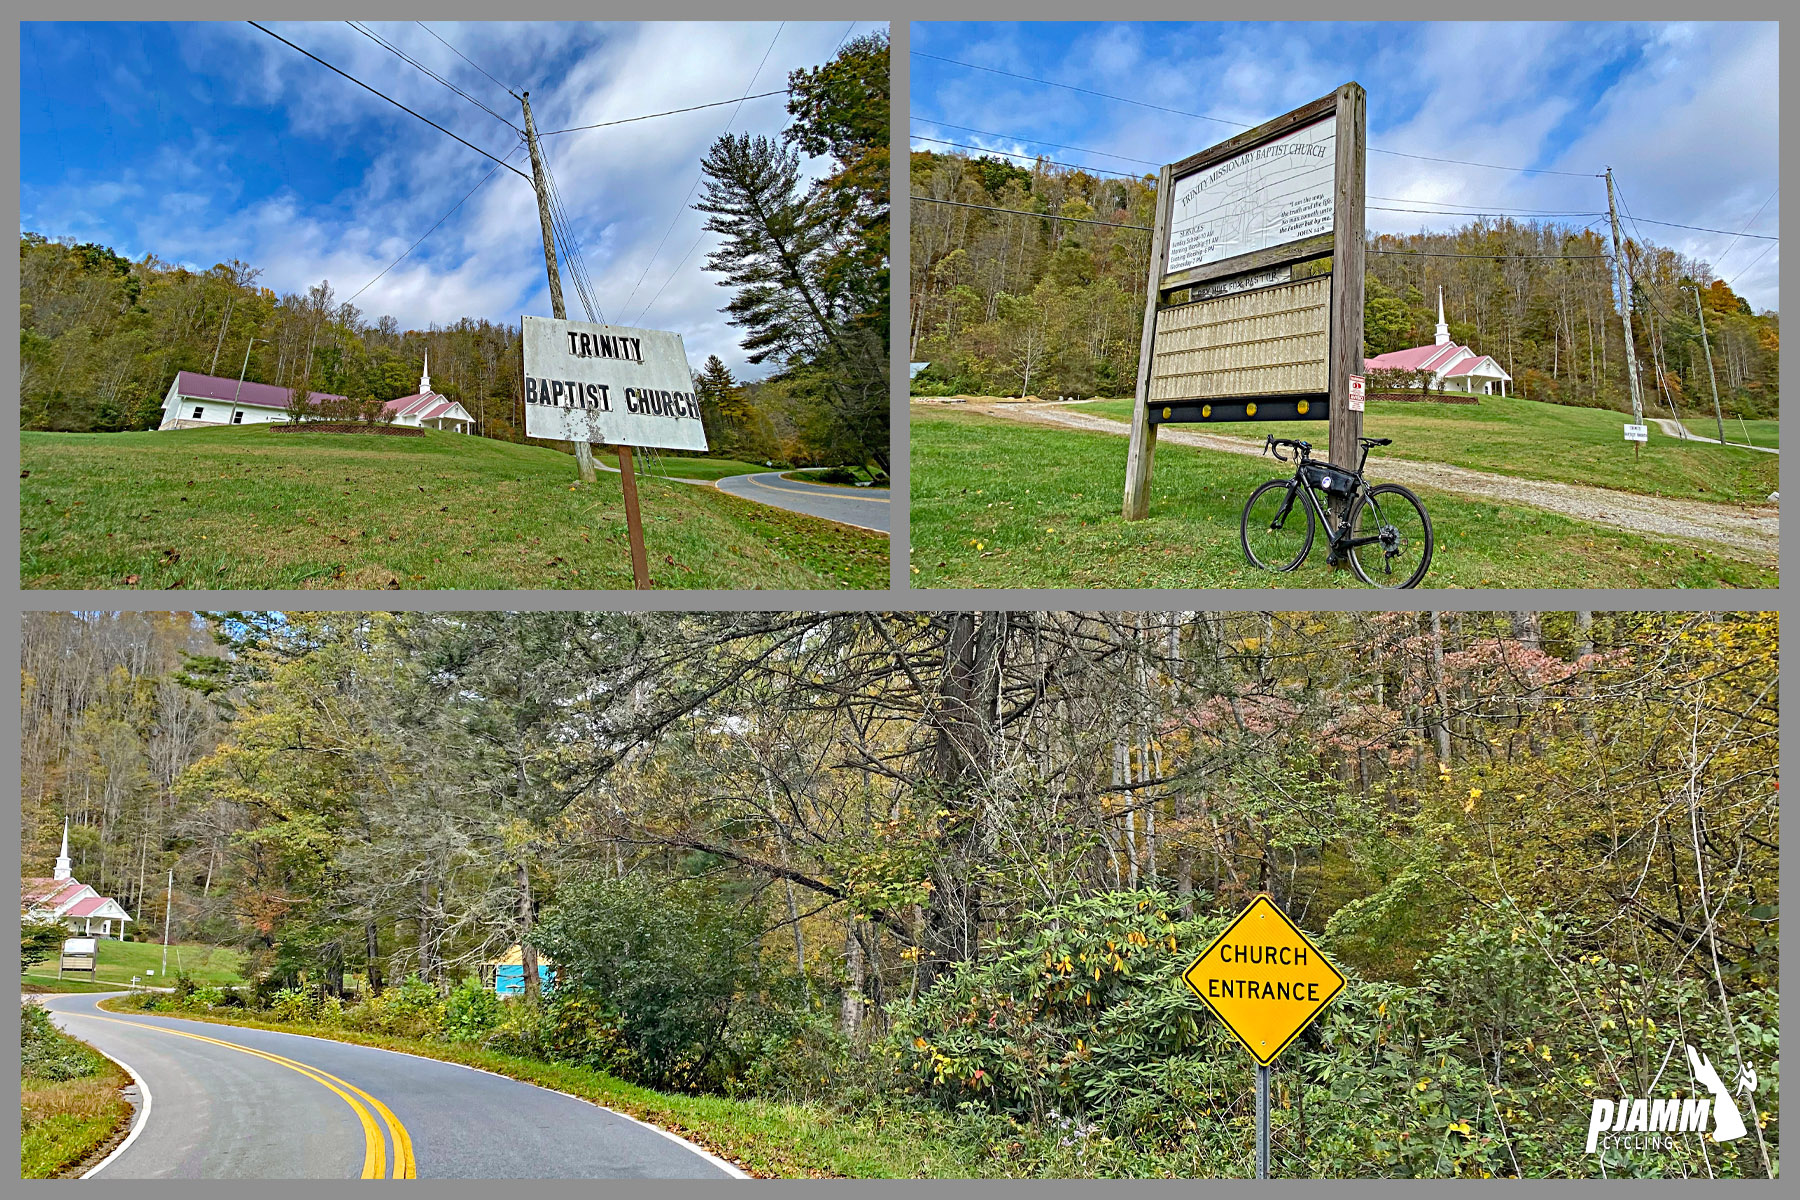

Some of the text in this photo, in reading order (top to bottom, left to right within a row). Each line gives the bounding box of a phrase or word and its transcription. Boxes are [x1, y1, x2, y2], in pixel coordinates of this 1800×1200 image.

[1182, 143, 1326, 206] TRINITY MISSIONARY BAPTIST CHURCH
[567, 331, 642, 361] TRINITY
[526, 377, 700, 418] BAPTIST CHURCH
[1220, 944, 1307, 966] CHURCH
[1208, 978, 1320, 1002] ENTRANCE
